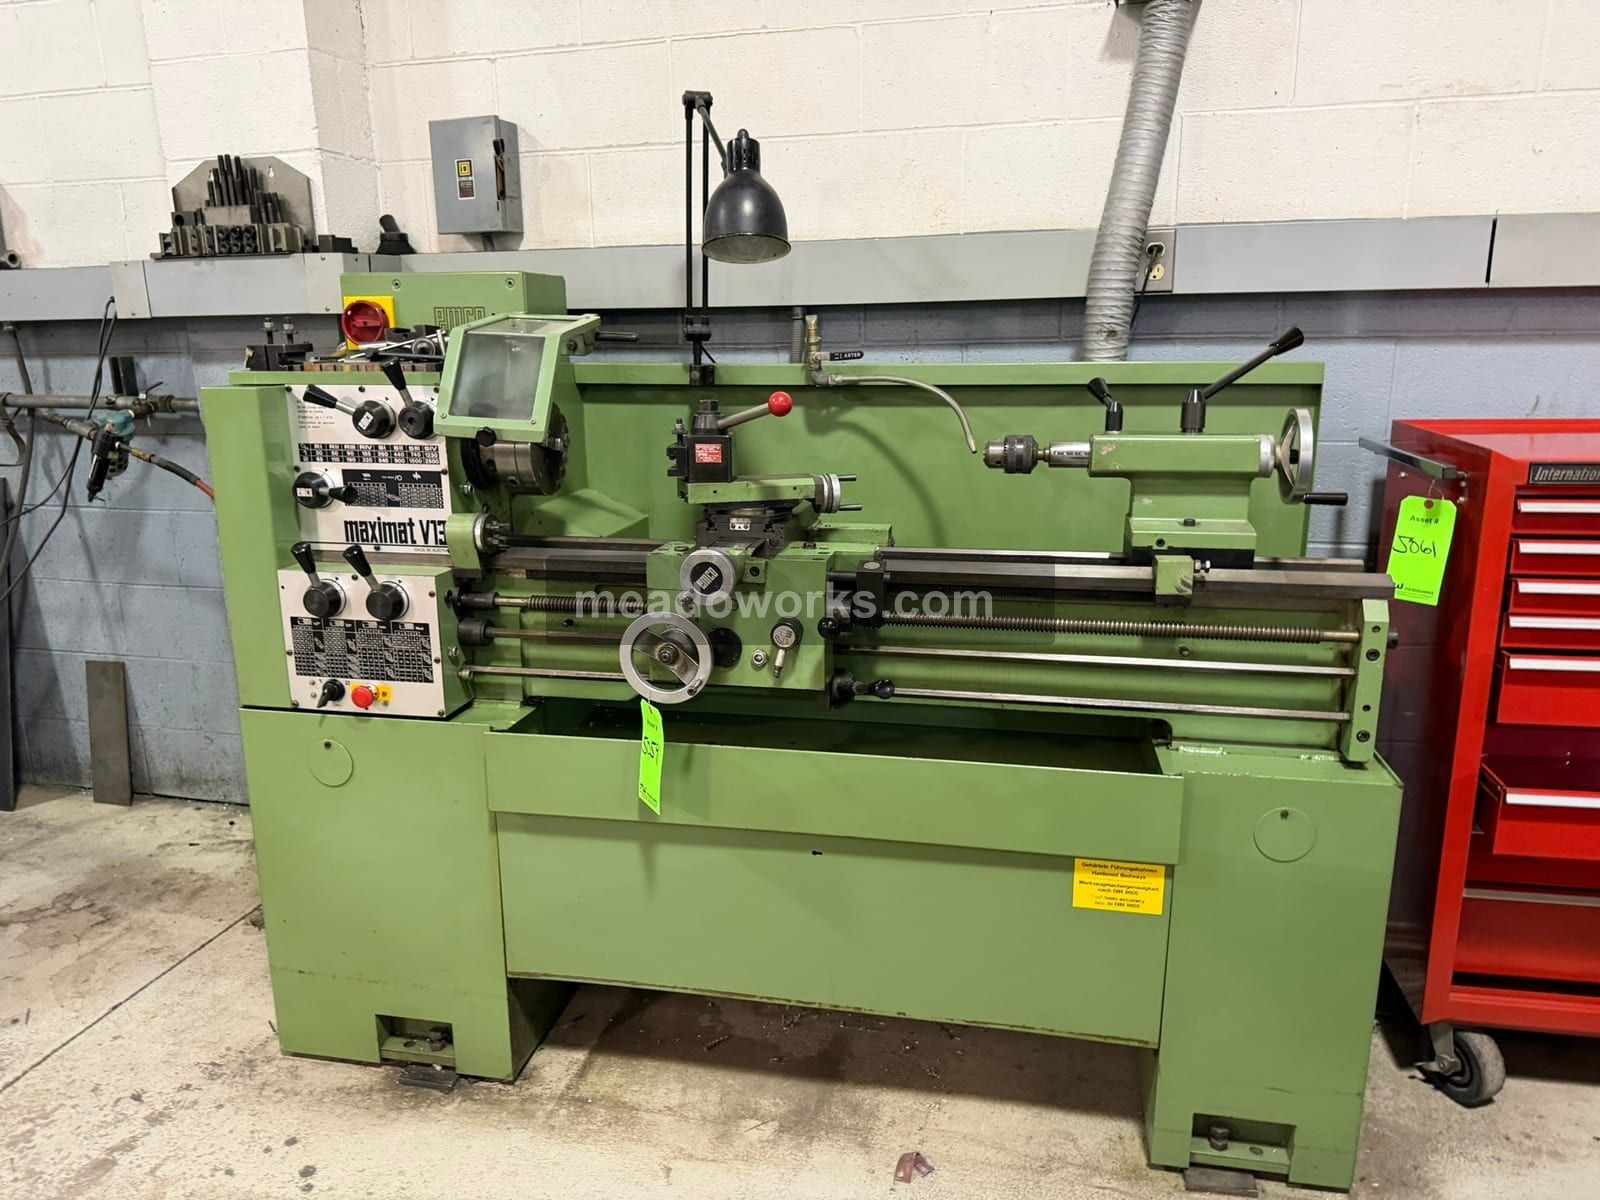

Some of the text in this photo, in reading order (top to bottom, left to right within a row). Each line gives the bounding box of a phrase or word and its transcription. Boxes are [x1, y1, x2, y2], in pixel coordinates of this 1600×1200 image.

[1410, 515, 1432, 524] Asset
[344, 516, 448, 546] maximat V13
